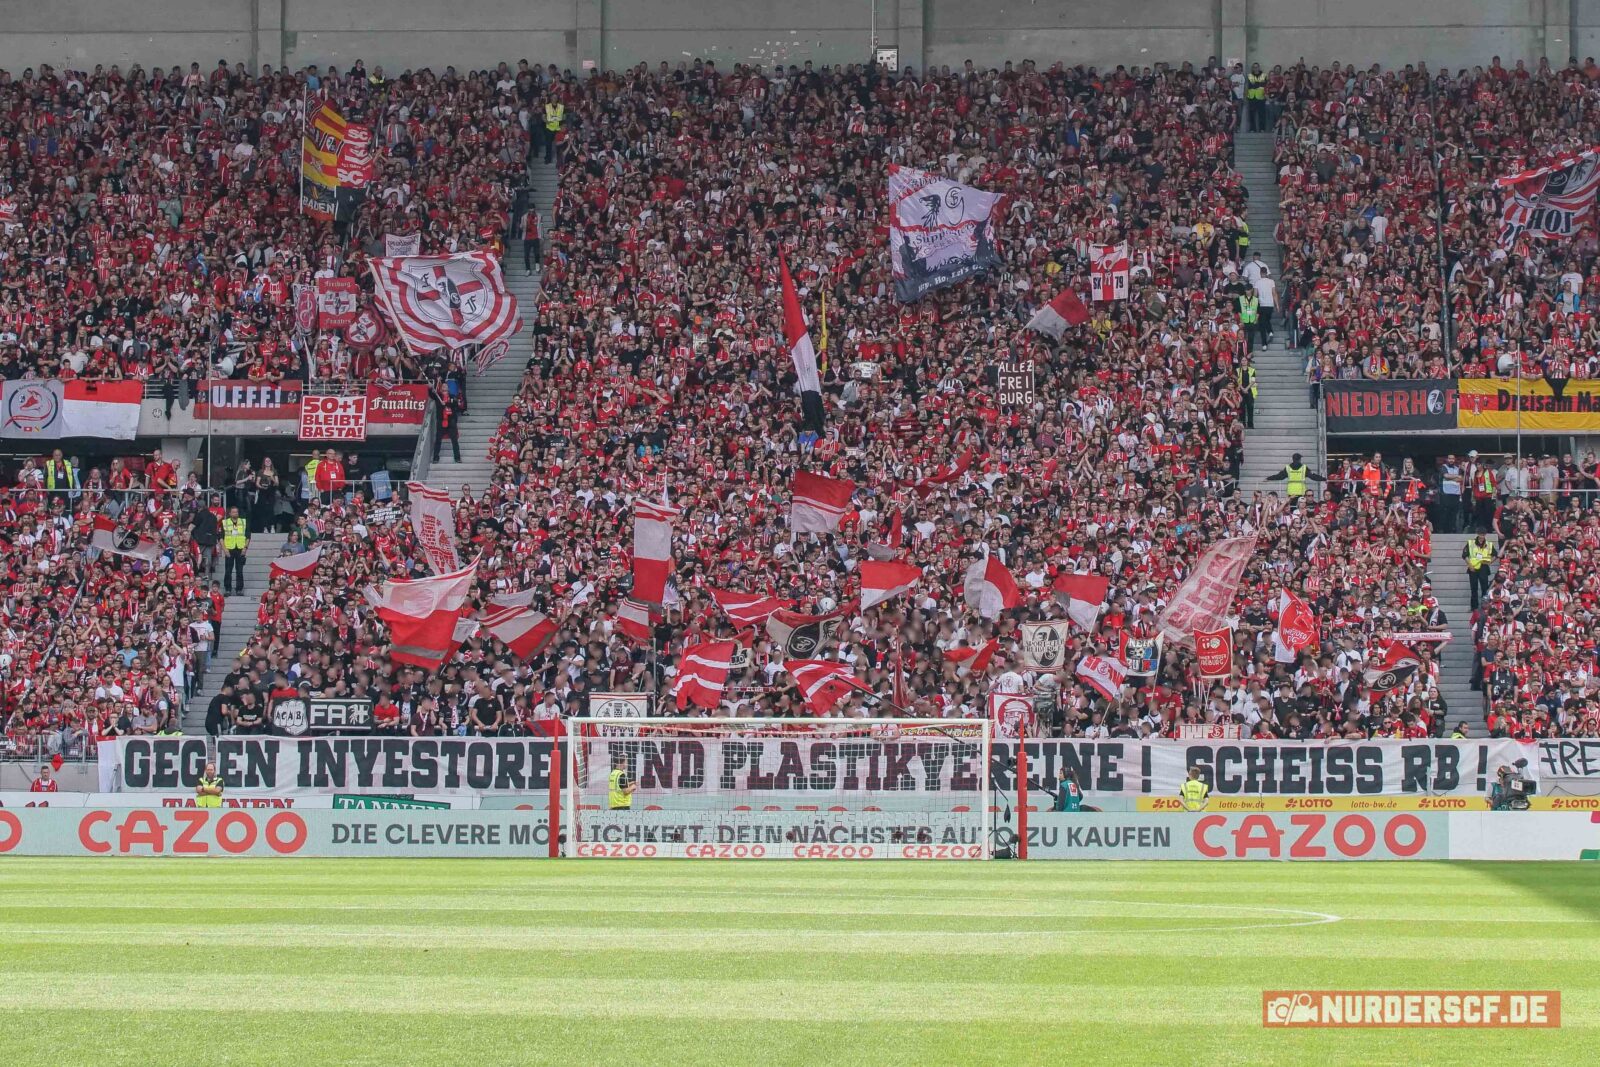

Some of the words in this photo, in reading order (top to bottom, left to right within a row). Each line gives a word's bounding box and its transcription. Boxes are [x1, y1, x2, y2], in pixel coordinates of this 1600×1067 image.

[1000, 360, 1032, 373] ALLEZ
[1000, 375, 1029, 390] FREI
[369, 396, 426, 411] Fanatics
[1000, 391, 1033, 405] BURG
[1497, 388, 1573, 413] Dreisam
[303, 397, 366, 414] 50+1
[303, 414, 364, 427] BLEIBT.
[302, 426, 362, 438] BASTA!
[124, 739, 281, 788] GEGEN
[1186, 745, 1383, 794] SCHEISS
[1401, 744, 1460, 793] RB
[1219, 801, 1265, 809] lotto-bw.de
[1300, 799, 1333, 808] LOTTO
[1350, 800, 1397, 809] lotto-bw.de
[1432, 799, 1466, 808] LOTTO
[1566, 799, 1599, 808] LOTTO
[78, 809, 308, 854] CAZOO
[332, 824, 377, 844] DIE
[385, 823, 501, 845] CLEVERE
[716, 825, 783, 843] DEIN
[792, 820, 933, 844] NÄCHSTES
[1026, 826, 1058, 847] ZU
[1067, 826, 1171, 847] KAUFEN
[1193, 814, 1427, 858] CAZOO
[577, 844, 657, 857] CAZOO
[686, 844, 766, 857] CAZOO
[794, 845, 874, 858] CAZOO
